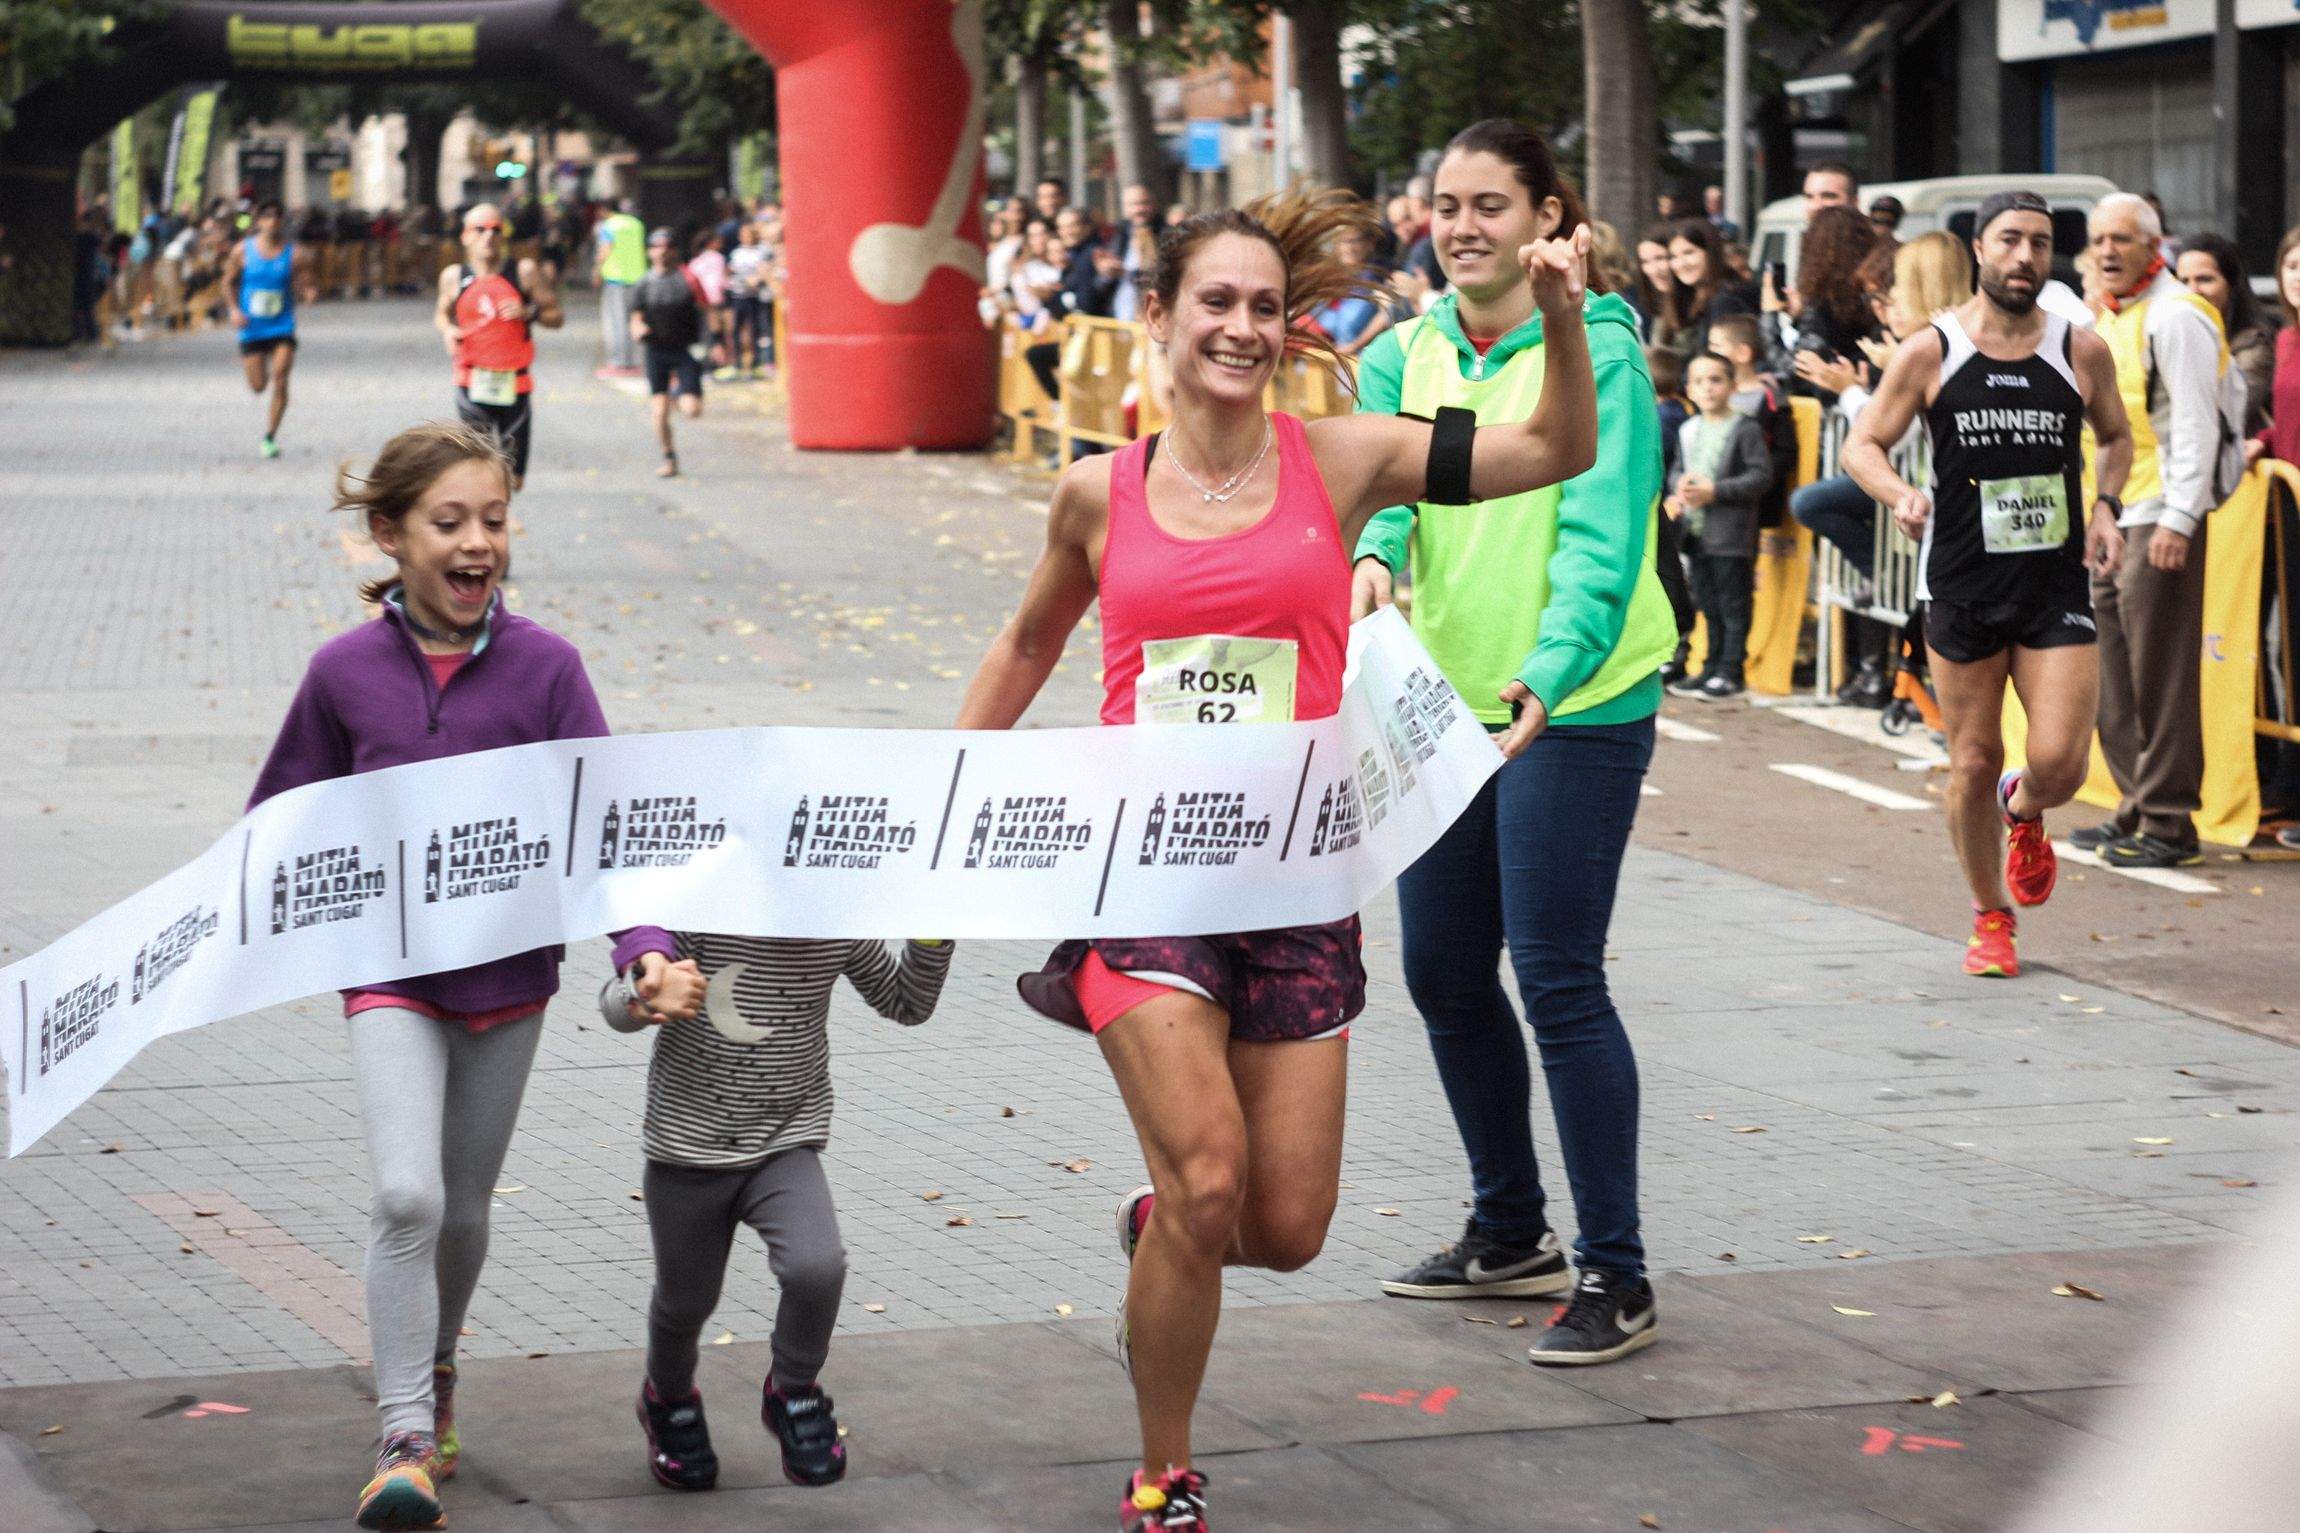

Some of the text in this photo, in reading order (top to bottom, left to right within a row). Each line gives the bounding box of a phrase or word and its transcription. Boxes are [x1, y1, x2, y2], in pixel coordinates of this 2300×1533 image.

[1953, 407, 2067, 434] RUNNERS
[1996, 494, 2057, 512] DANIEL
[1178, 668, 1257, 696] ROSA
[1197, 702, 1236, 723] 62
[627, 796, 696, 824] MITJA
[816, 796, 889, 823] MITJA
[999, 796, 1067, 823] MITJA
[1173, 792, 1245, 819] MITJA
[450, 816, 518, 853] MITJA
[294, 844, 360, 883] MITJA
[622, 853, 652, 868] SANT
[806, 853, 881, 869] SANT CUGAT
[987, 854, 1058, 869] SANT CUGAT
[1164, 851, 1238, 866] SANT CUGAT
[447, 875, 521, 900] SANT CUGAT
[293, 909, 324, 930] SANT
[53, 1042, 75, 1066] SANT
